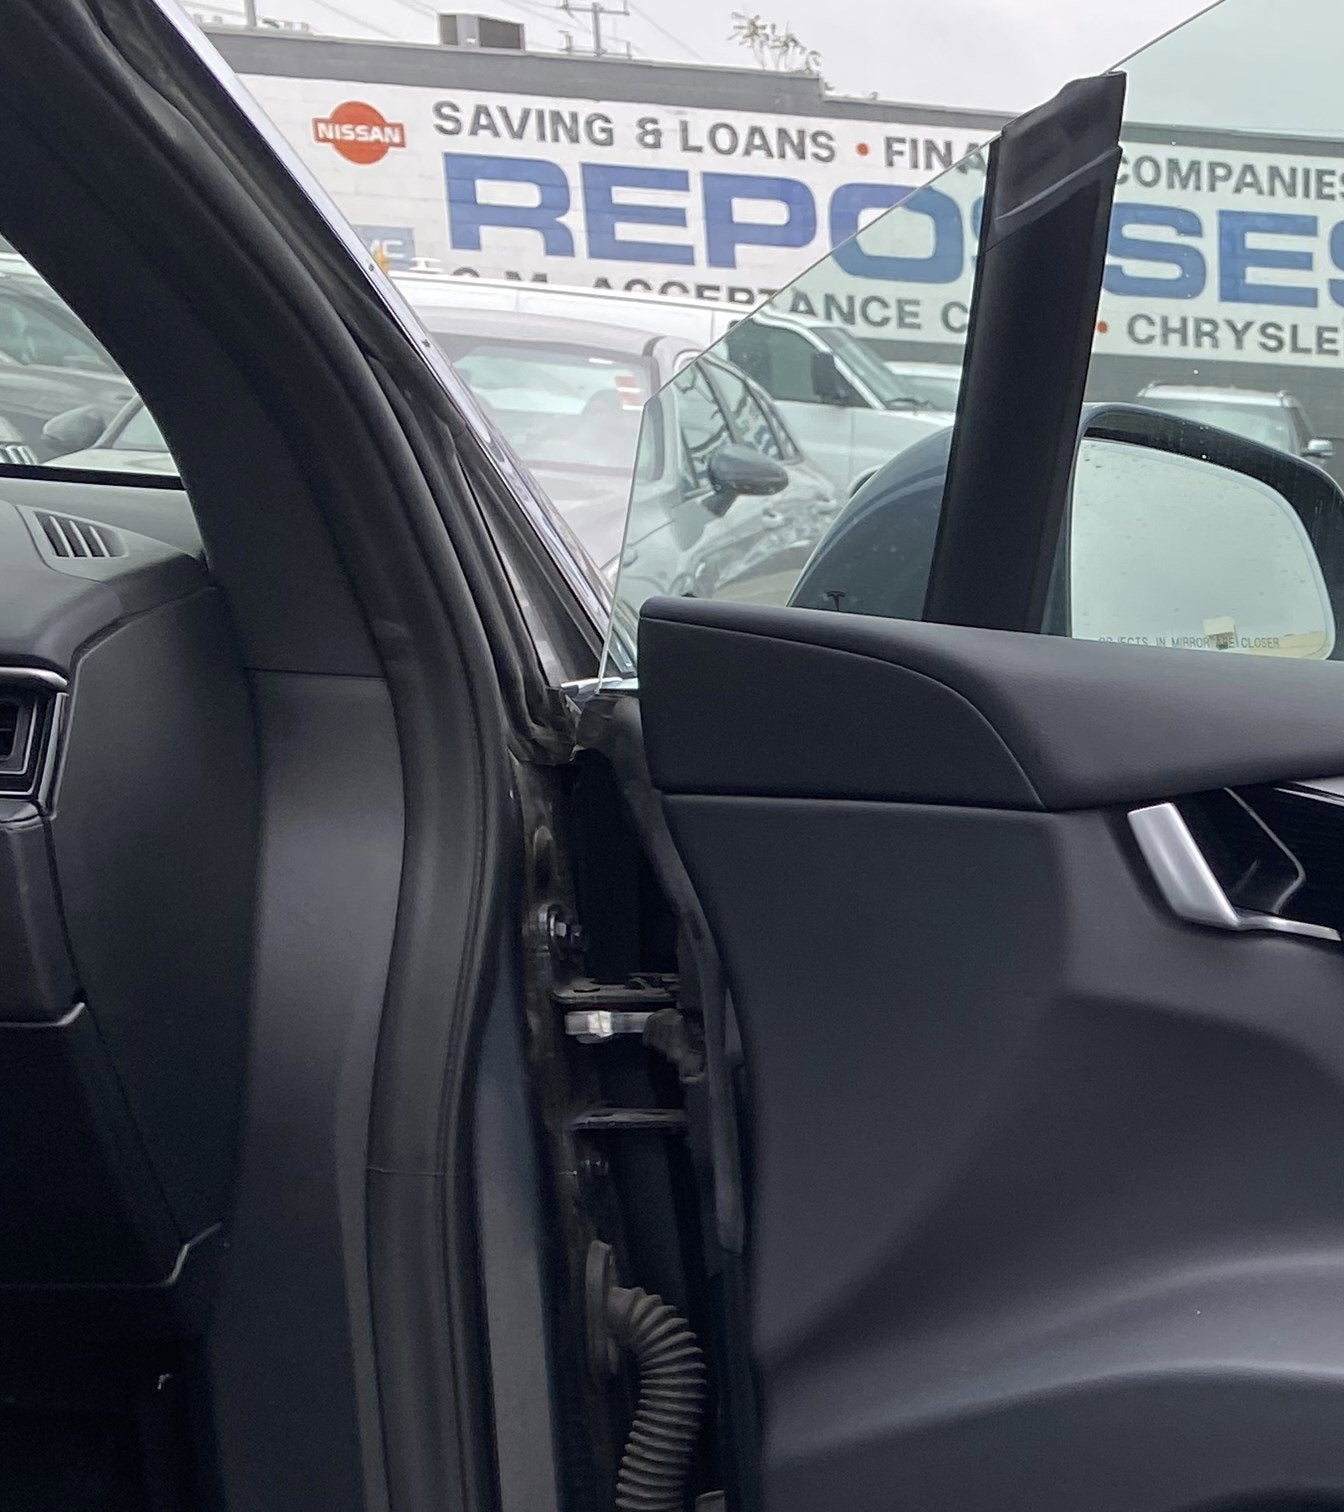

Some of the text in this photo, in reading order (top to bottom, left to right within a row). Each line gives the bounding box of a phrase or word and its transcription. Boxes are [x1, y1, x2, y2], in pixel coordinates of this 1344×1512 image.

[316, 122, 401, 144] NISSAN
[432, 100, 615, 147] SAVING
[635, 116, 663, 149] &
[678, 118, 837, 163] LOANS
[884, 136, 989, 175] FINA
[1171, 636, 1210, 649] MIRROR
[1240, 637, 1281, 649] CLOSER
